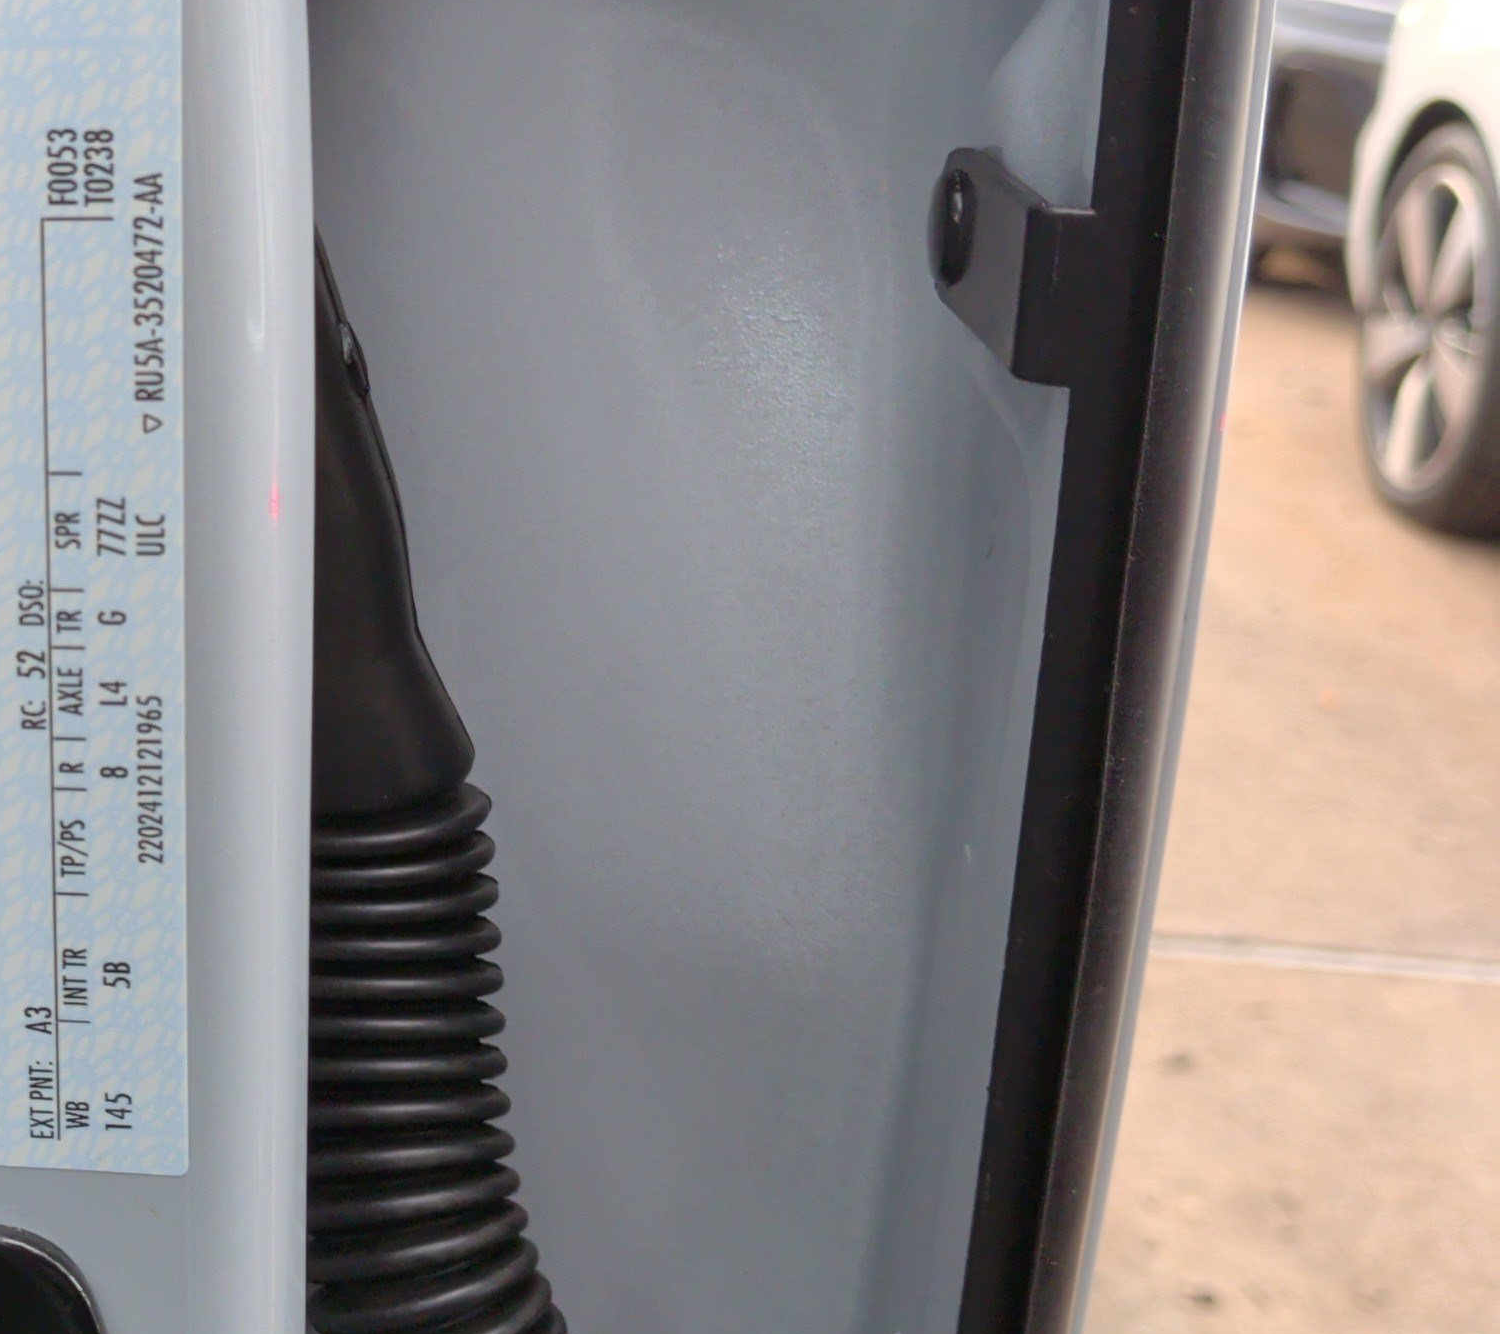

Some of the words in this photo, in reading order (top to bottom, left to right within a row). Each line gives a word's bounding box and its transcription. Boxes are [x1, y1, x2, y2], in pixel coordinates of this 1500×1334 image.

[48, 128, 77, 206] F0053
[86, 129, 114, 206] T0238
[133, 173, 164, 401] RU5A-3520472-AA
[56, 513, 80, 549] SPR
[97, 498, 126, 556] 77ZZ
[137, 514, 164, 555] ULC
[19, 580, 44, 626] DSO:
[57, 611, 82, 632] TR
[18, 650, 44, 678] 52
[57, 667, 83, 715] AXLE
[100, 681, 126, 707] L4
[21, 701, 46, 730] RC:
[137, 696, 164, 863] 2202412121965
[60, 819, 87, 877] TP/PS
[63, 948, 87, 969] TR
[103, 961, 130, 988] 5B
[64, 977, 88, 1006] INT
[26, 1006, 51, 1034] A3
[29, 1061, 53, 1100] PNT:
[30, 1108, 54, 1139] EXT
[66, 1101, 89, 1128] WB
[105, 1092, 132, 1130] 145
